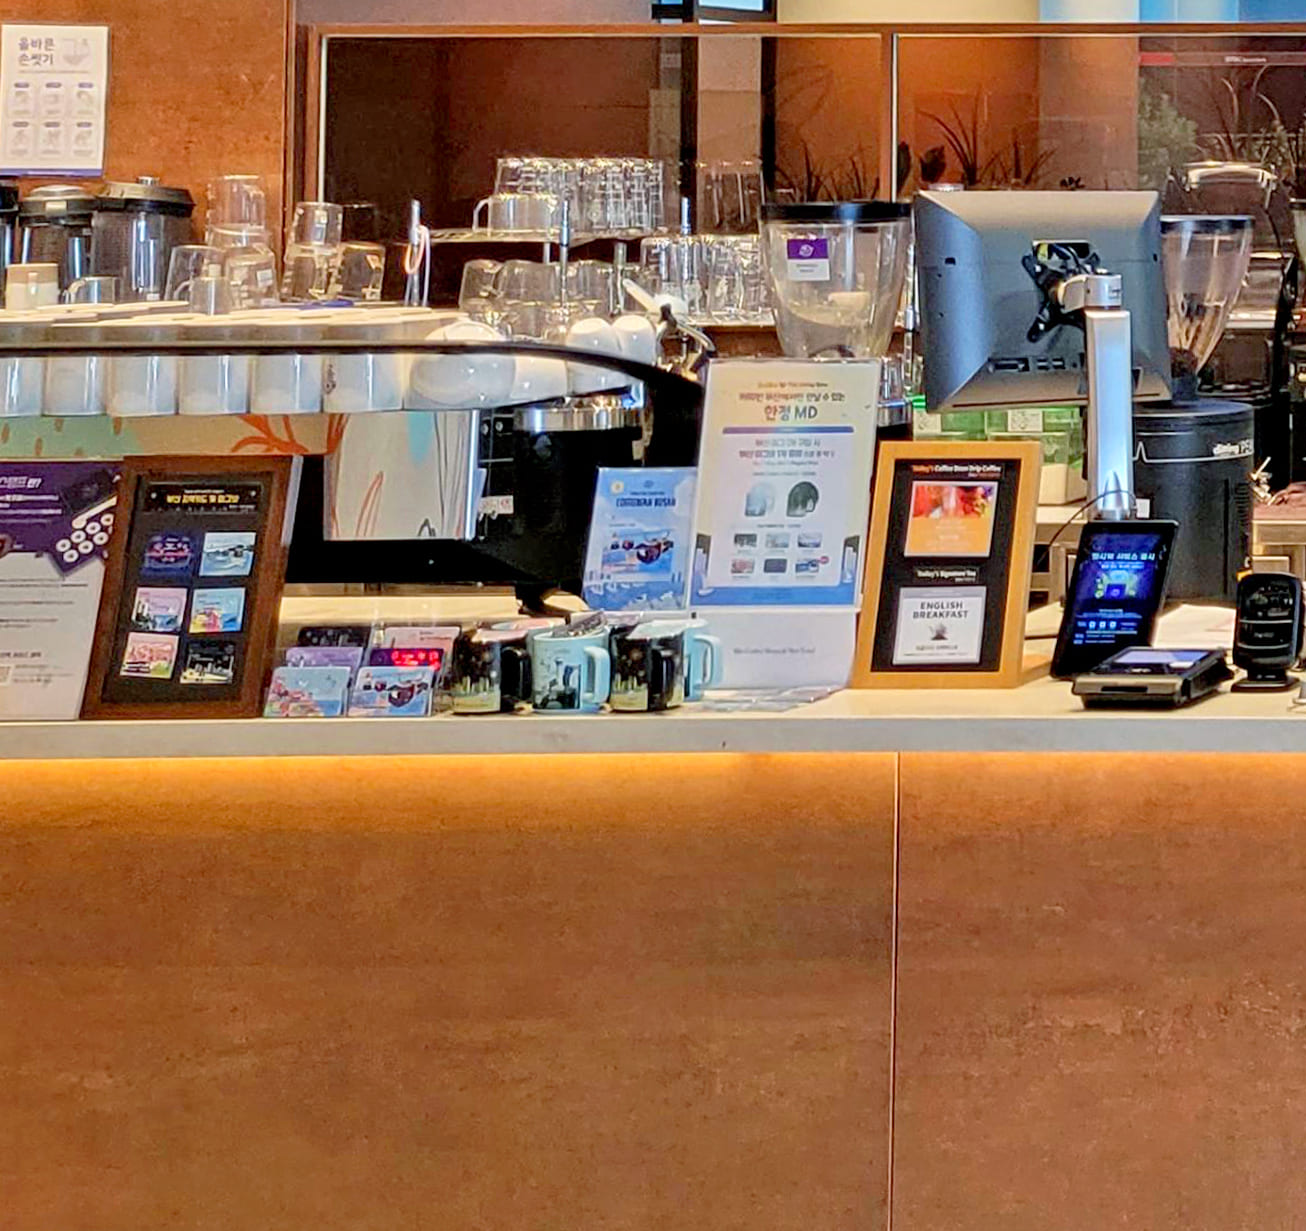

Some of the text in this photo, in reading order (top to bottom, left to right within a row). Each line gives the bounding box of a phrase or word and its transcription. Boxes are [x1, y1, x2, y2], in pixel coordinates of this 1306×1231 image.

[18, 37, 56, 52] 올바른
[18, 53, 55, 66] 손씻기
[764, 405, 819, 422] 한정 MD
[920, 601, 963, 610] ENGLISH
[912, 609, 969, 620] BREAKFAST
